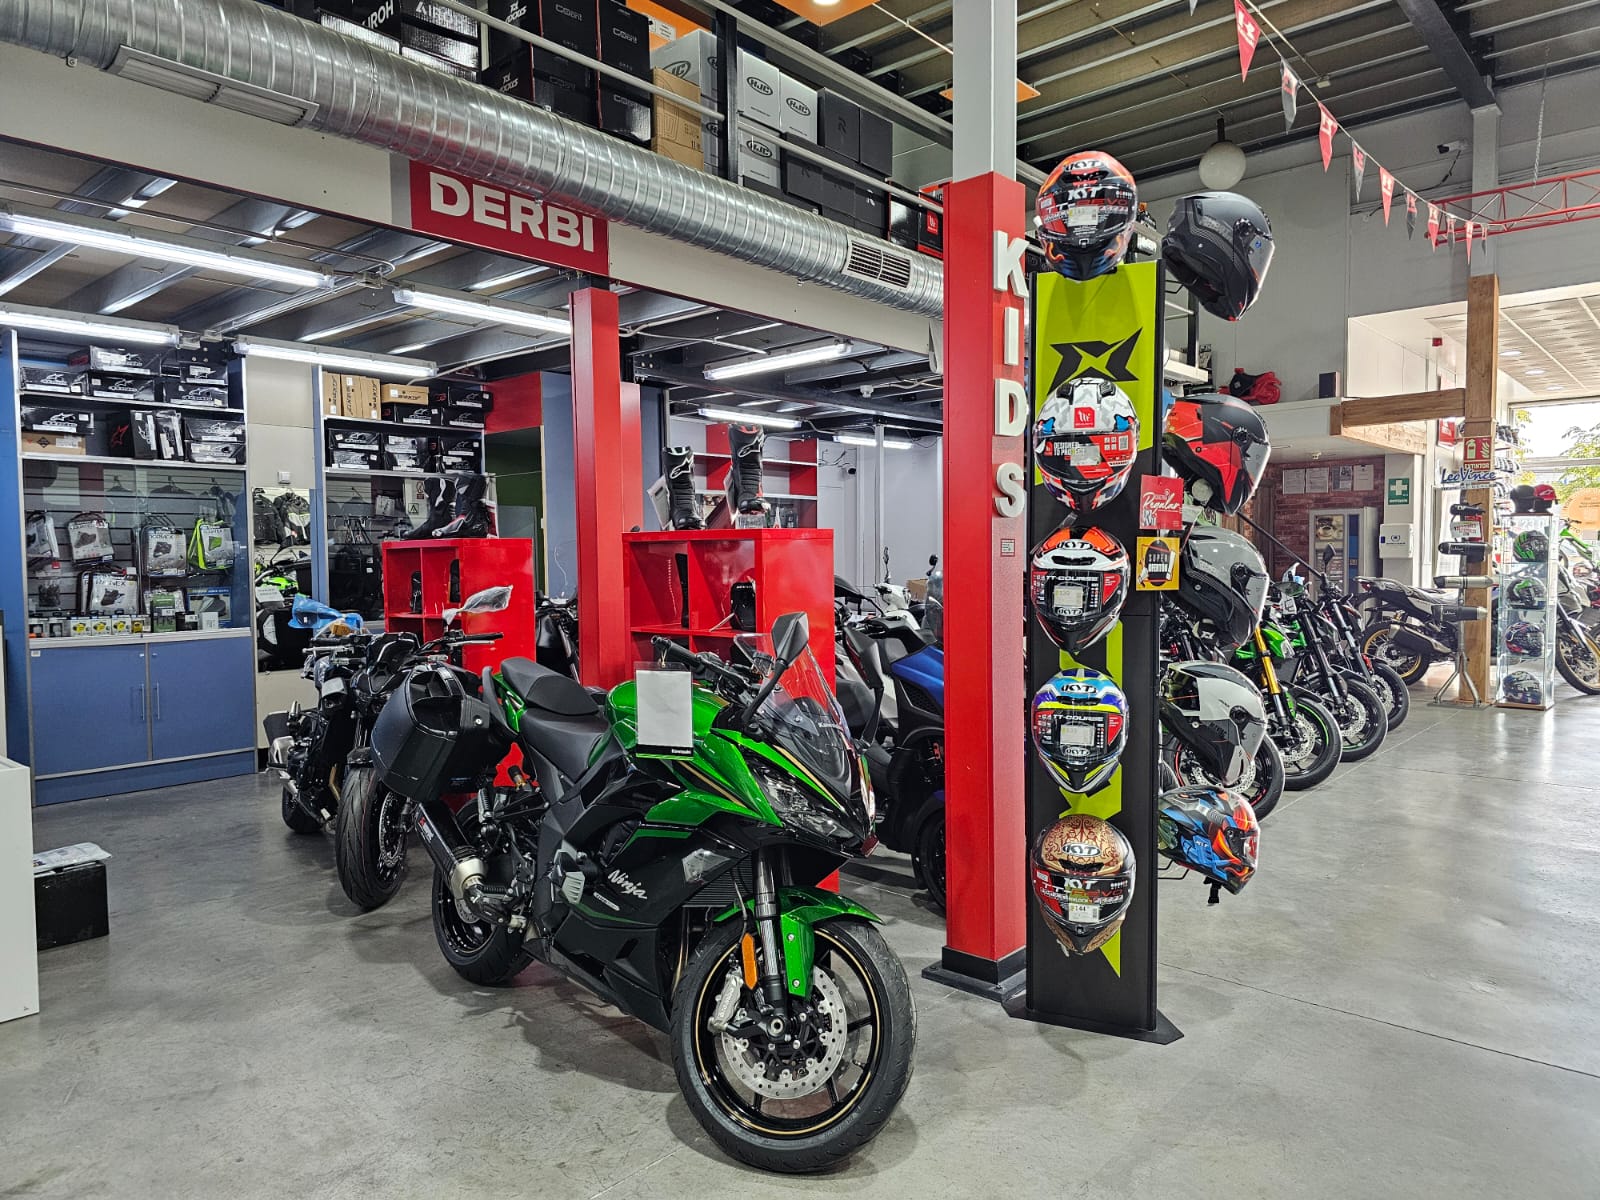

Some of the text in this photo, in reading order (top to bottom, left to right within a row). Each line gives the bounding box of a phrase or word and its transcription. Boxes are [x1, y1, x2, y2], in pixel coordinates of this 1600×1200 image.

[749, 79, 771, 94] HJC
[788, 99, 811, 114] HJC
[748, 142, 772, 157] HJC
[1067, 186, 1102, 201] KYT
[429, 171, 595, 253] DERBI
[993, 230, 1030, 518] KIDS
[1441, 466, 1497, 483] LeoVince
[607, 869, 648, 900] Ninja
[1063, 877, 1098, 890] KYT
